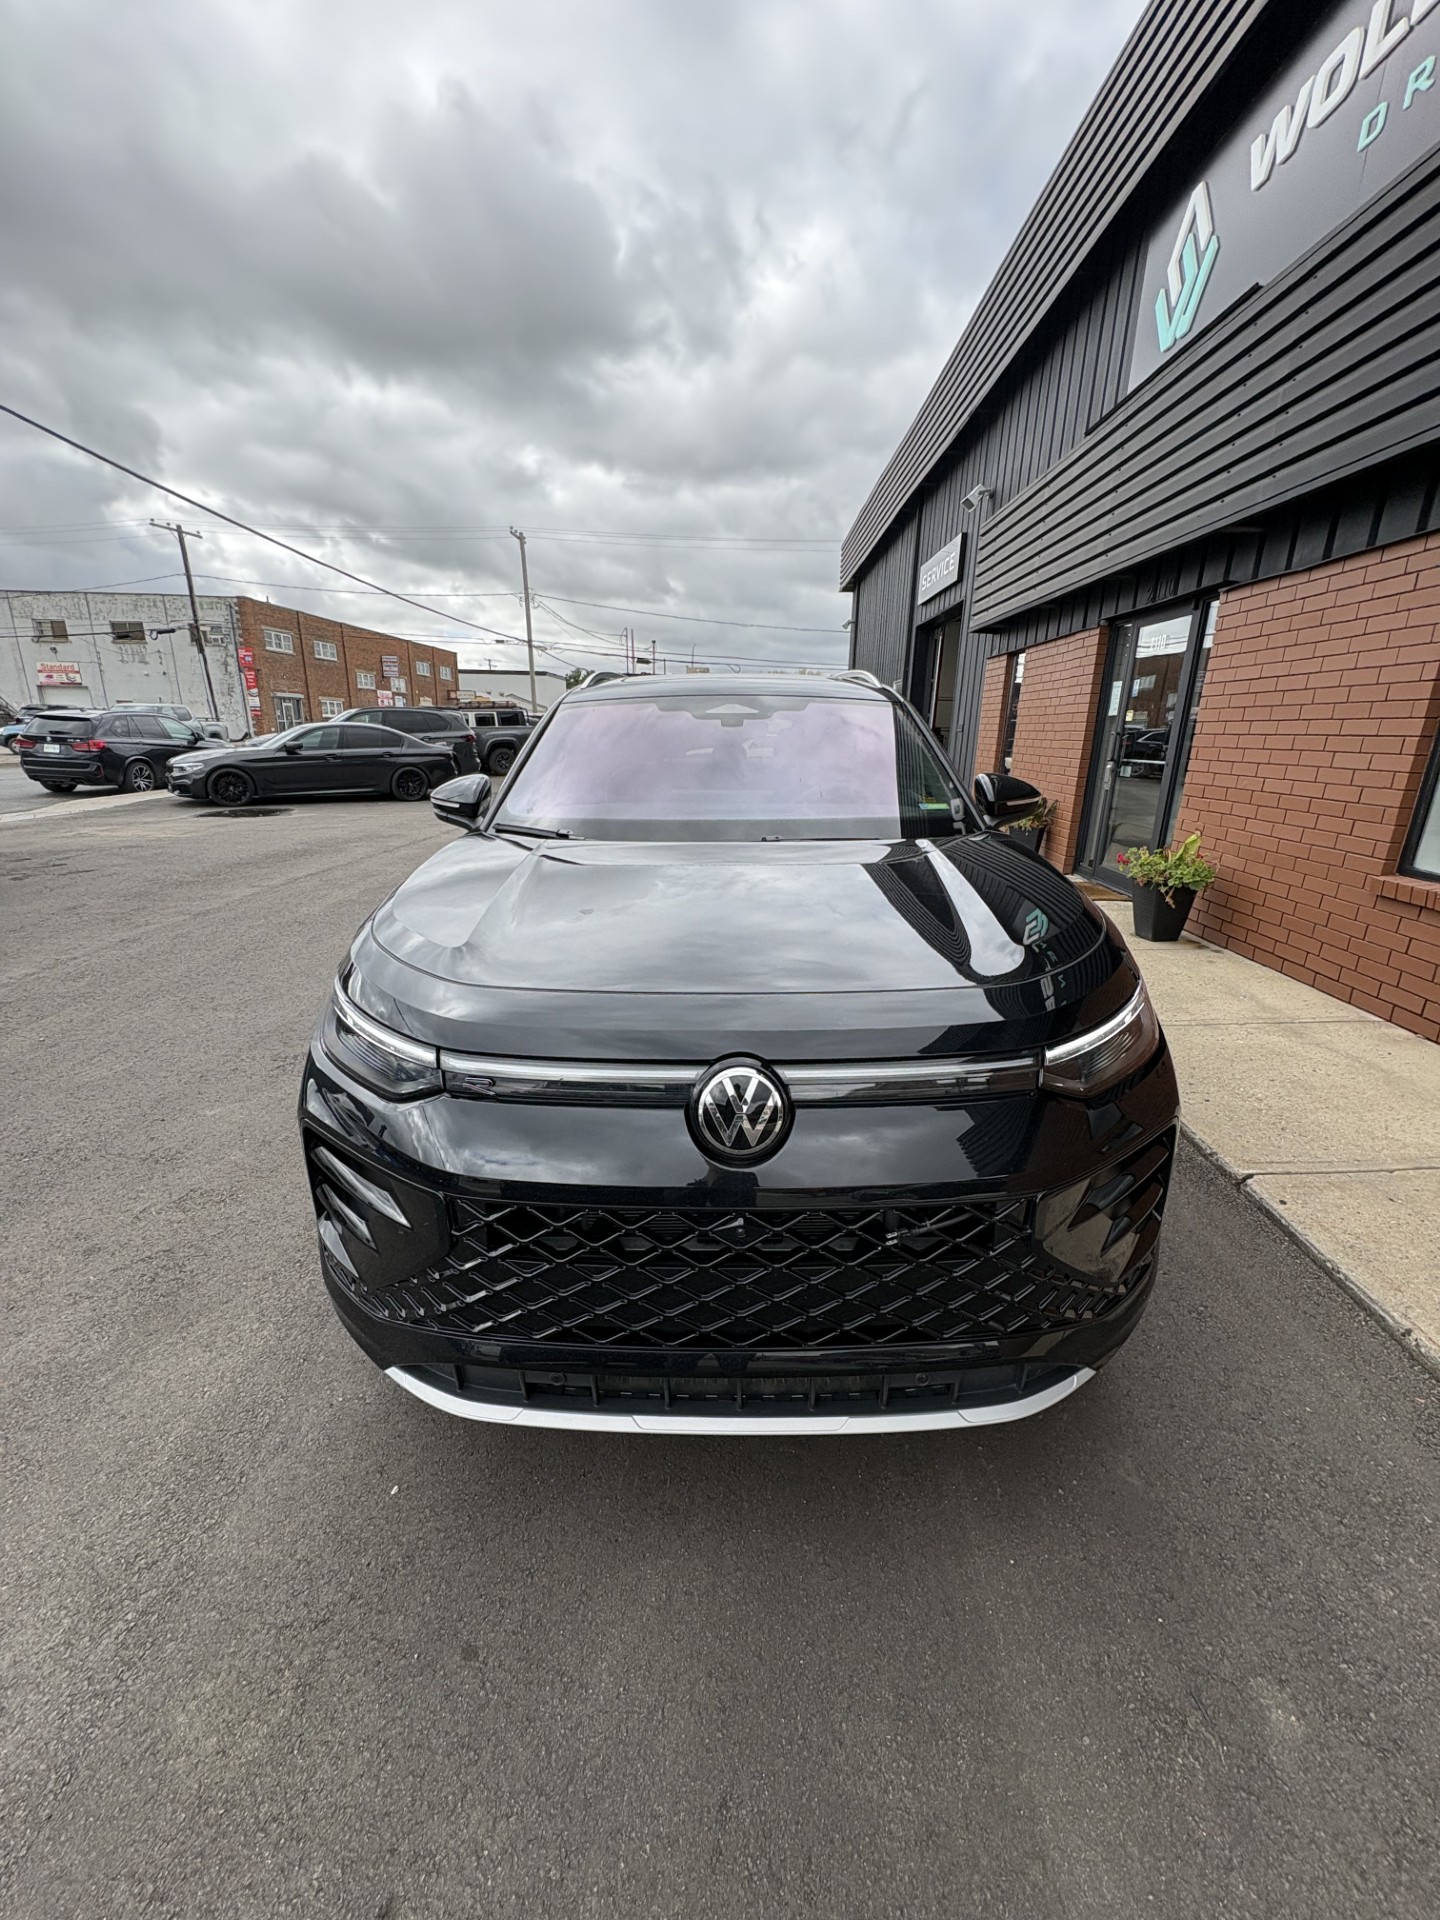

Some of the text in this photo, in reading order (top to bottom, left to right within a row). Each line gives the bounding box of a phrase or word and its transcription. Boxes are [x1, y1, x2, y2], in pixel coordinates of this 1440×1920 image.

[921, 551, 957, 591] SERVICE
[40, 663, 75, 671] Standard
[702, 1073, 779, 1149] VW
